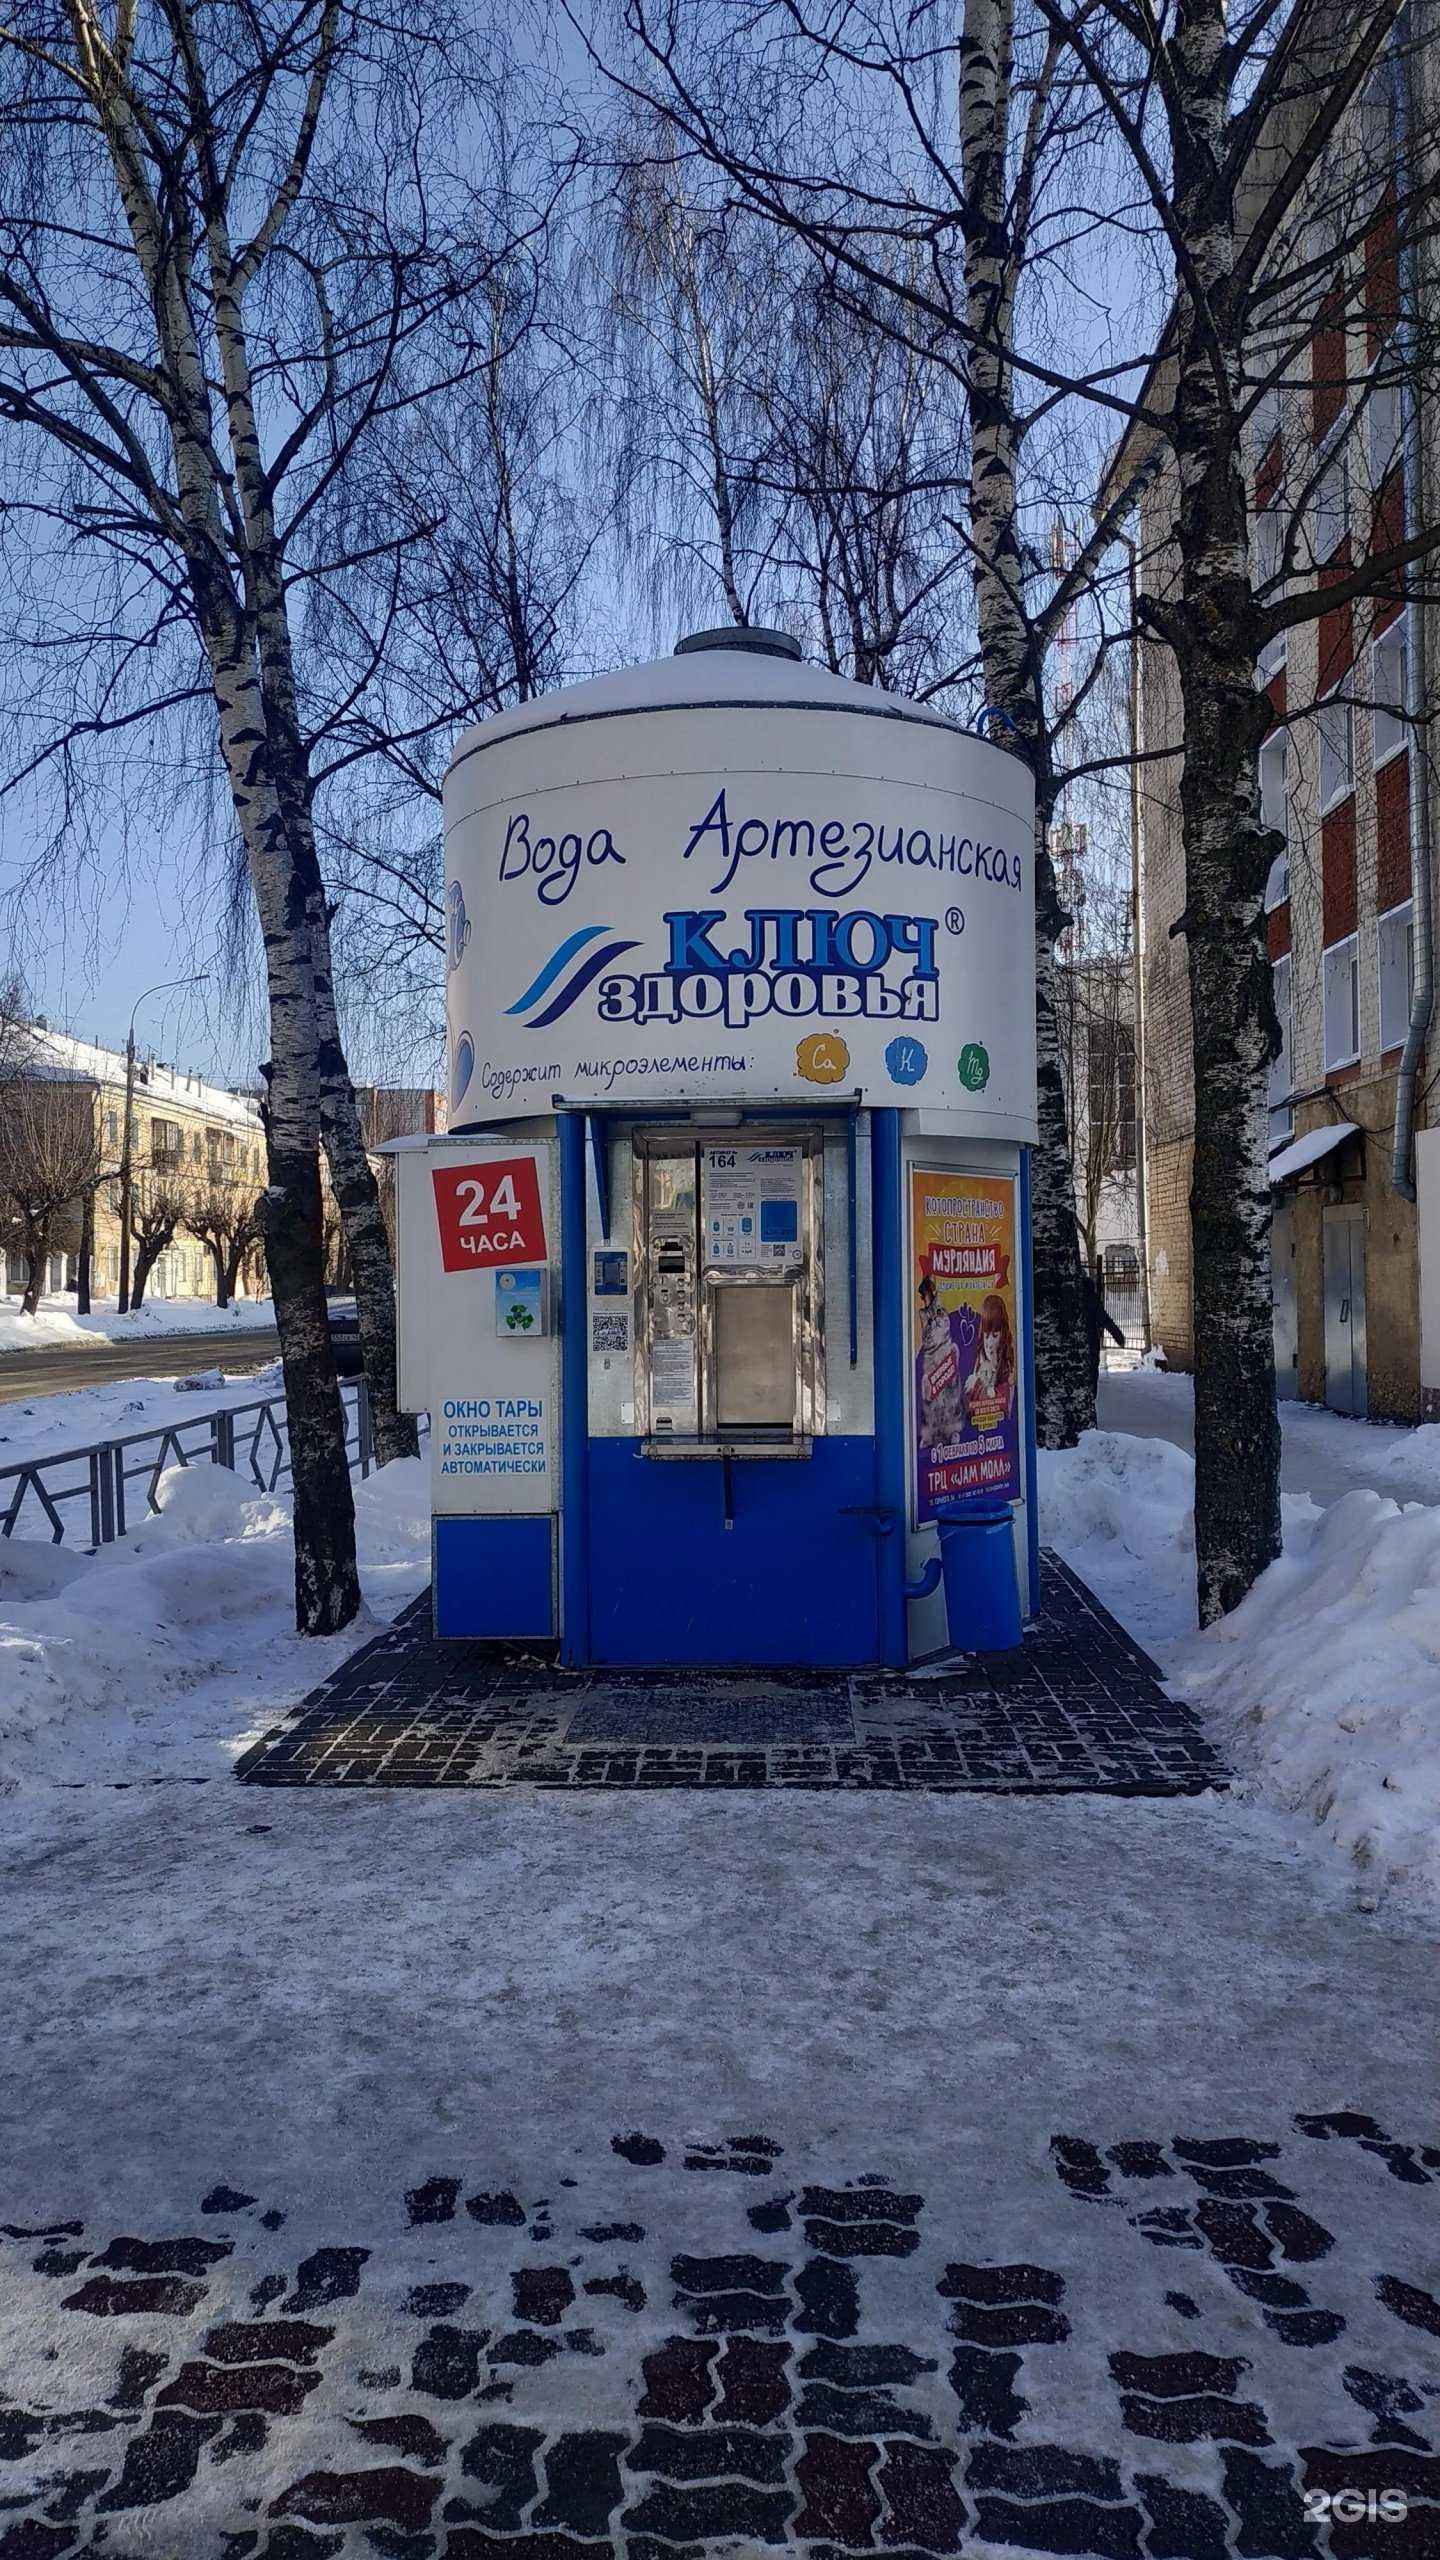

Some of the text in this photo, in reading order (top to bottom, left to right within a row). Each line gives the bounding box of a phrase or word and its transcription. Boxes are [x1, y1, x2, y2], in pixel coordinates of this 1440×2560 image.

[500, 788, 1023, 905] Вода Артезианская
[663, 909, 939, 978] КЛЮЧ
[481, 1055, 755, 1099] Содержит микроэлементы:
[709, 1154, 737, 1169] 164
[455, 1174, 522, 1227] 24
[460, 1230, 527, 1255] ЧАСА
[943, 1220, 985, 1245] СТРАНА
[932, 1248, 996, 1275] МУРЛЯНДИЯ
[443, 1400, 543, 1419] ОКНО ТАРЫ
[448, 1424, 539, 1438] ОТКРЫВАЕТСЯ
[443, 1442, 544, 1456] И ЗАКРЫВАЕТСЯ
[441, 1460, 546, 1475] АВТОМАТИЧЕСКИ
[928, 1470, 948, 1493] ТРЦ
